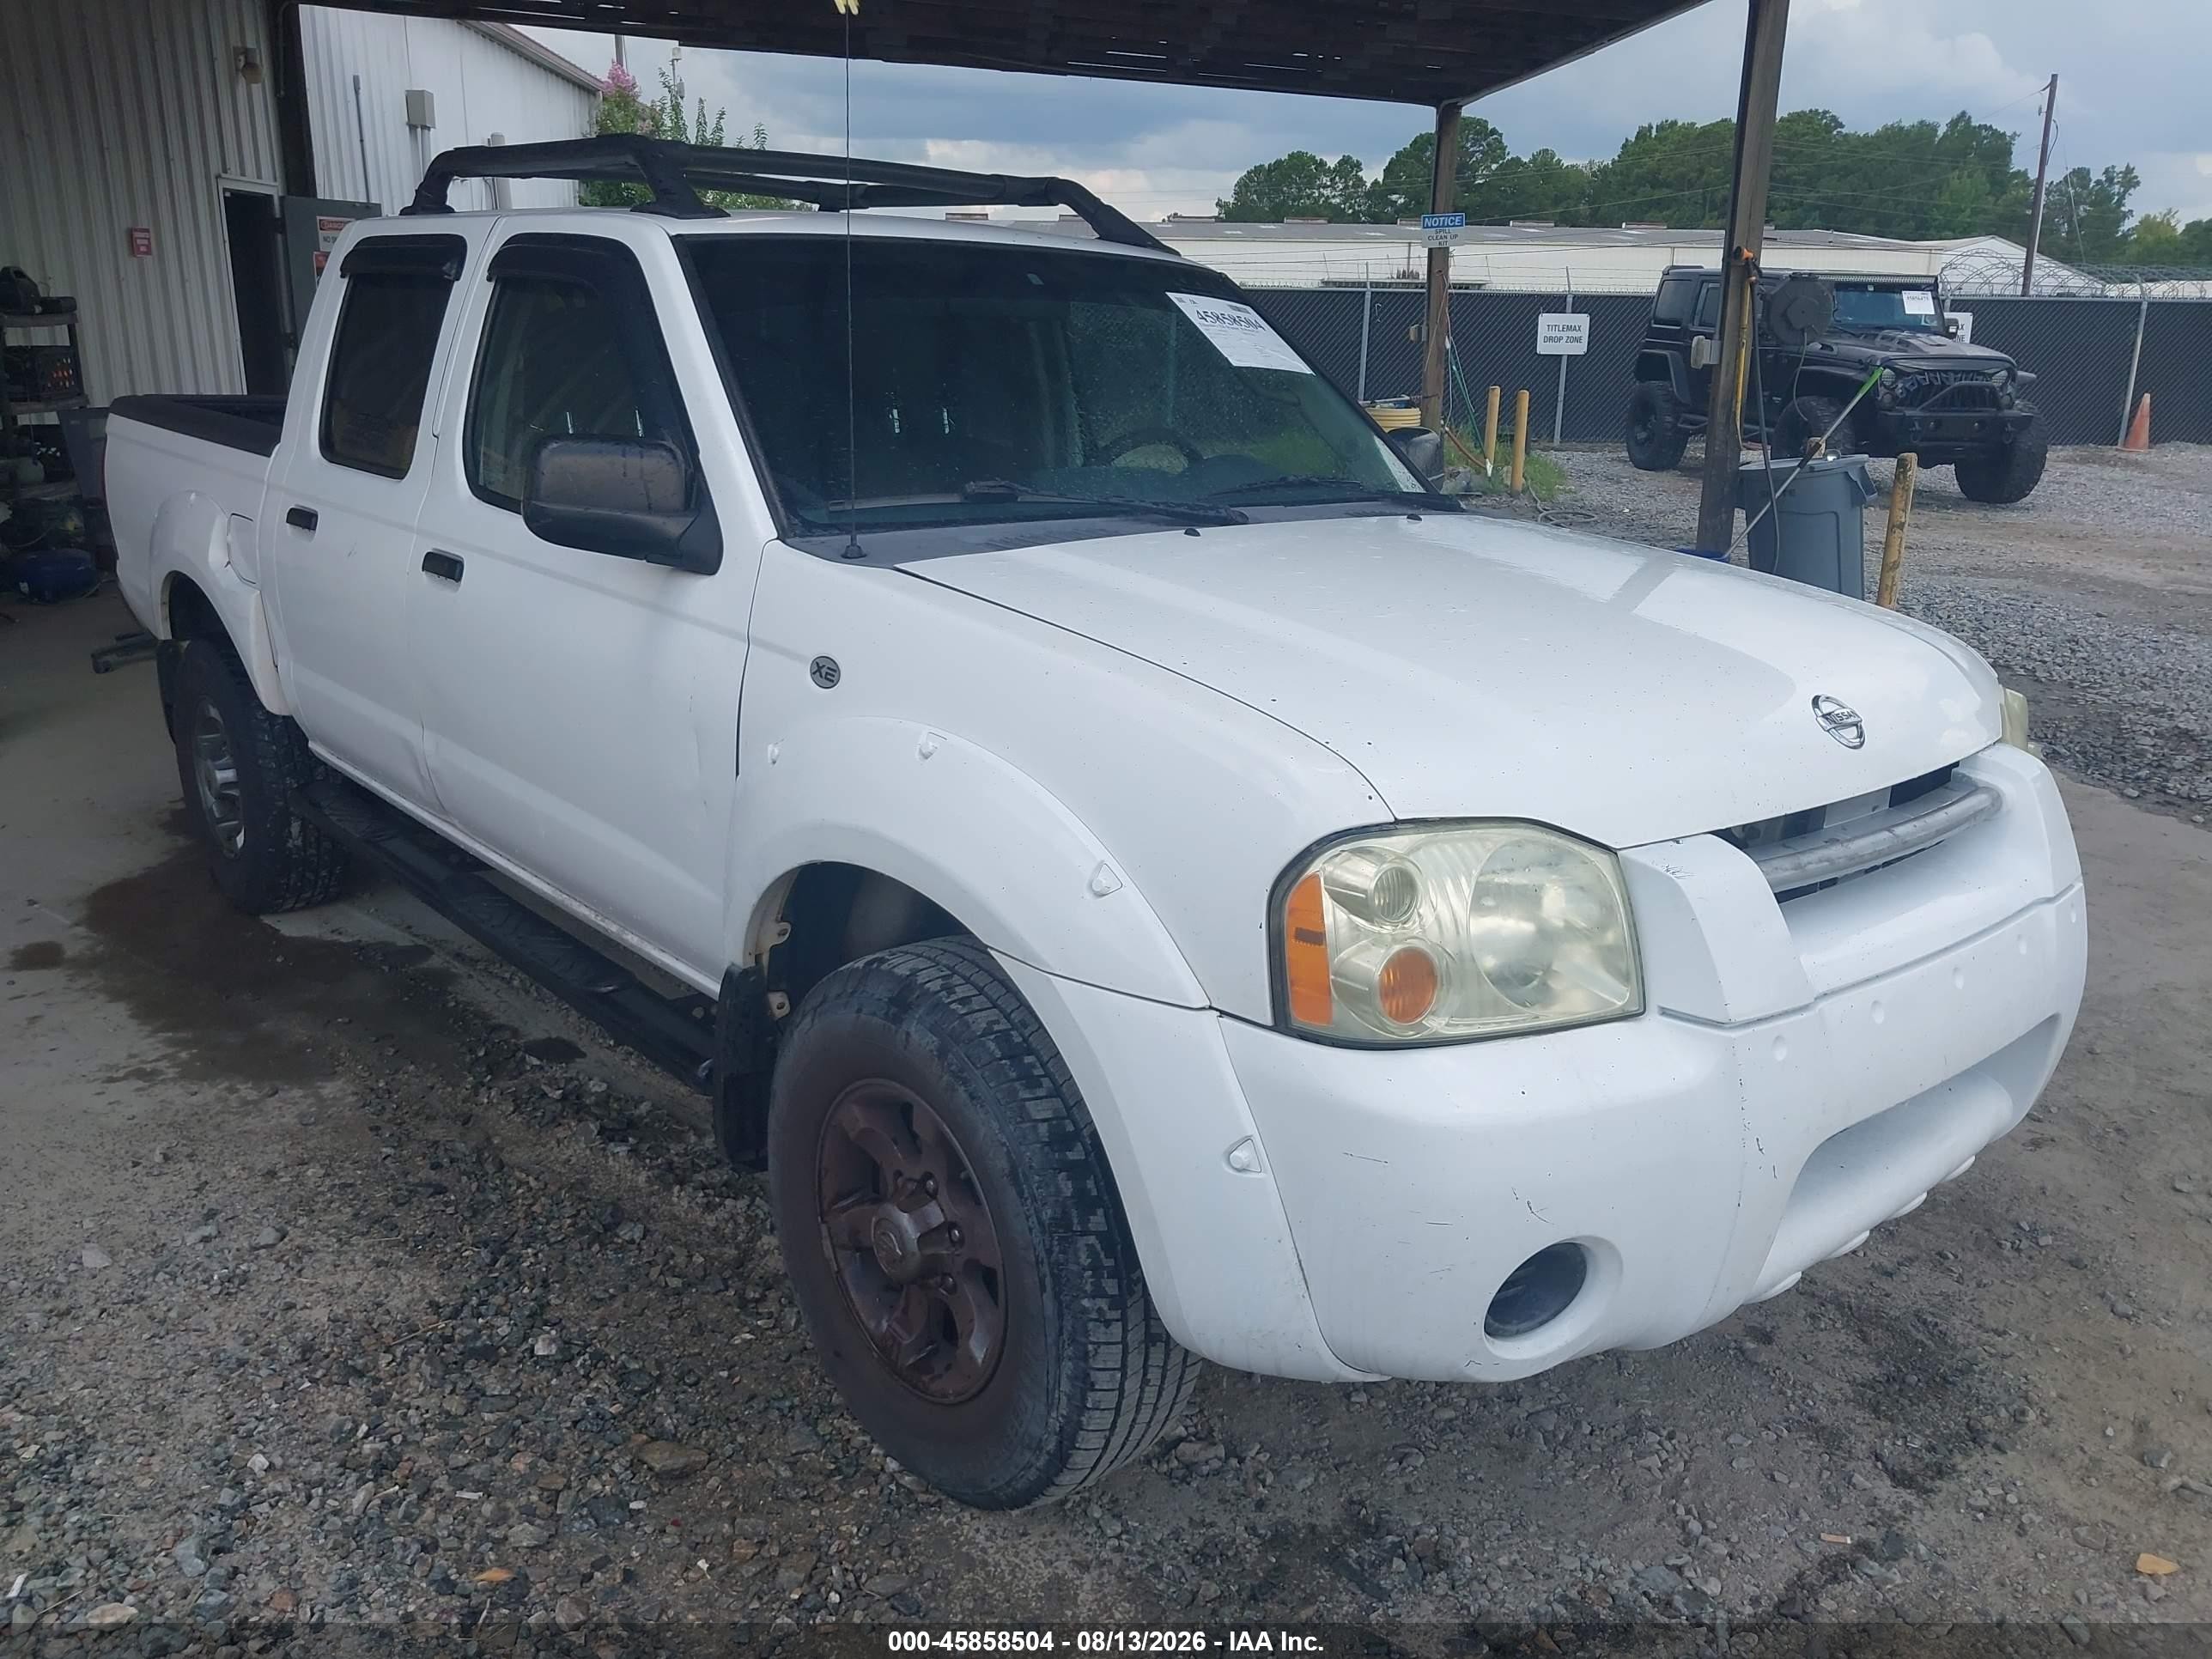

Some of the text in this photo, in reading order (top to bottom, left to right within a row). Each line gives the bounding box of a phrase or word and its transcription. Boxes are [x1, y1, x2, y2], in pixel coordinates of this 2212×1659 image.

[1424, 216, 1462, 228] NOTICE
[1195, 309, 1267, 331] 45858504
[1546, 324, 1582, 332] TITLEMAX
[1543, 335, 1583, 343] DROP ZONE
[812, 661, 837, 684] XE
[1826, 710, 1856, 726] NISSAN
